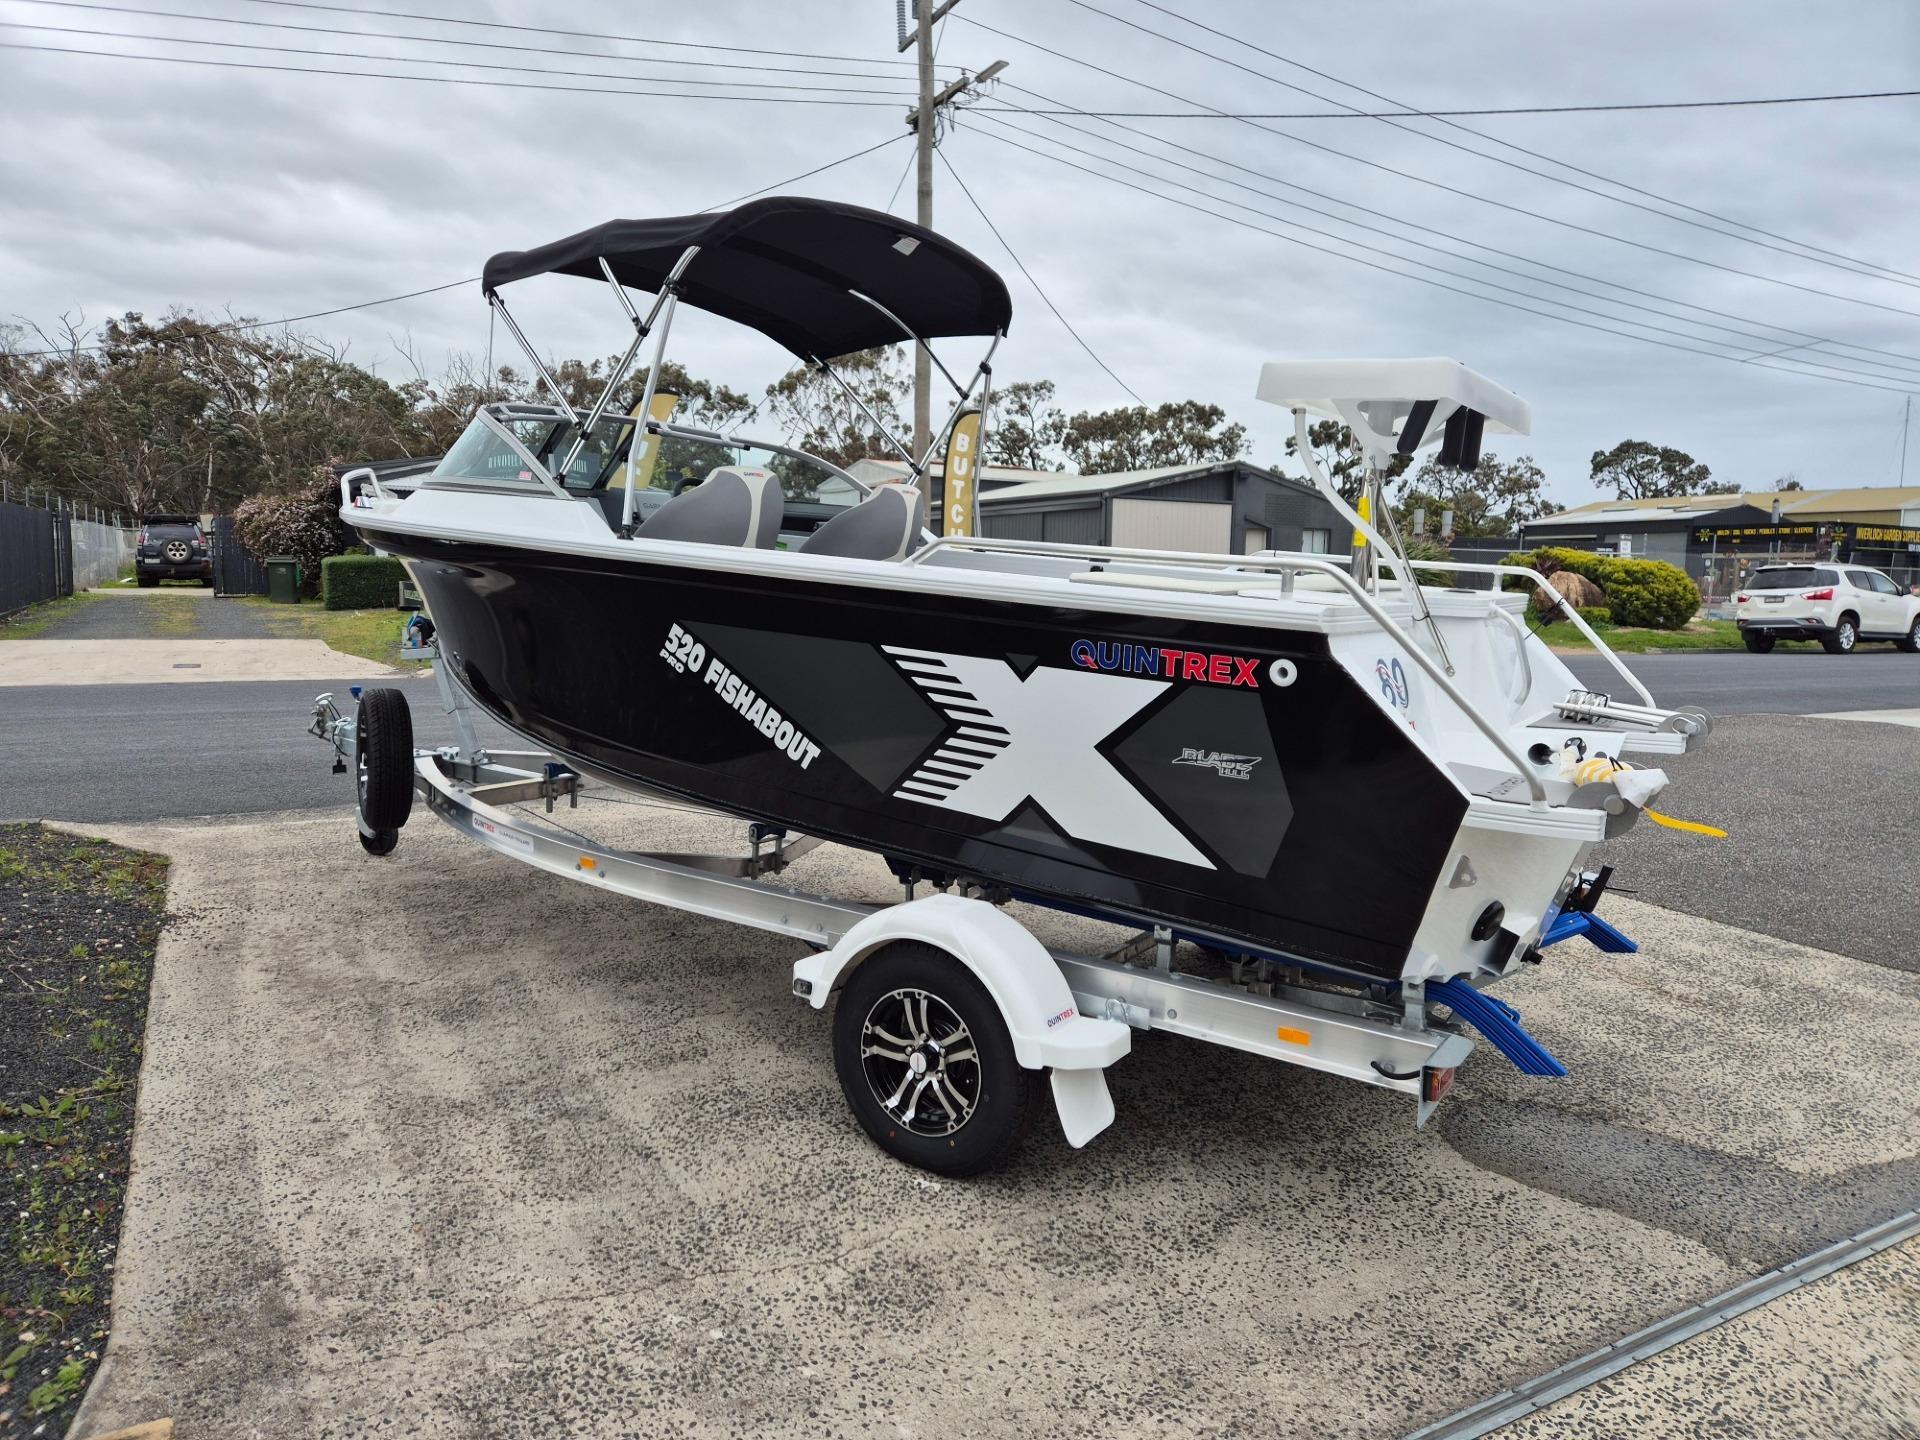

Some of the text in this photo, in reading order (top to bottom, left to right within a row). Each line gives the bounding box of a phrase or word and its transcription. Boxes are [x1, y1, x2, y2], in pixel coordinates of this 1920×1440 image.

[659, 648, 685, 674] PRO
[1070, 638, 1260, 687] QUINTREX
[664, 622, 822, 770] 520 FISHABOUT
